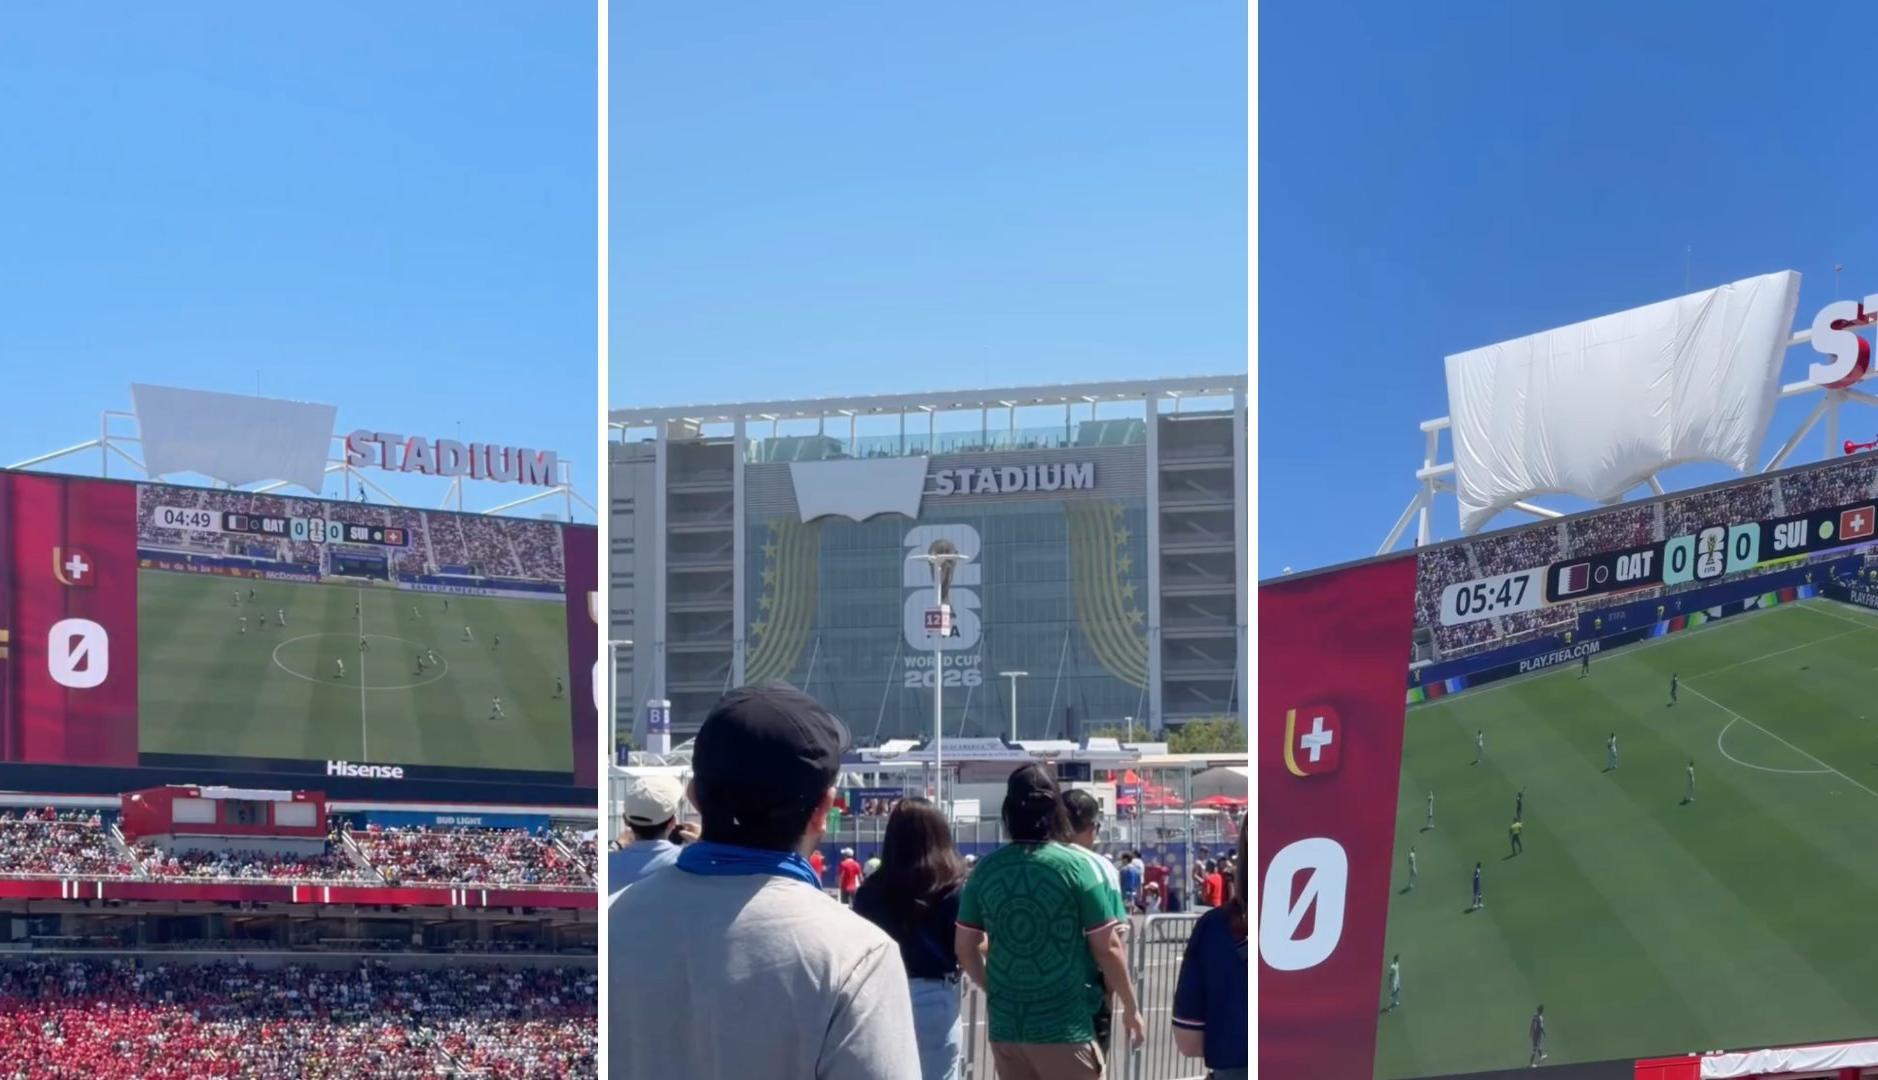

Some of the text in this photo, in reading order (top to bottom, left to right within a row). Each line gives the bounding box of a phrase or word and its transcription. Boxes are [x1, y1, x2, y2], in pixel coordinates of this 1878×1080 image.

[346, 429, 558, 487] STADIUM
[935, 462, 1094, 496] STADIUM
[164, 509, 211, 528] 04:49
[263, 518, 285, 533] QAT
[295, 522, 304, 536] 0
[330, 525, 339, 539] 0
[350, 527, 369, 541] SUI
[1774, 519, 1808, 551] SUI
[1736, 532, 1751, 561] 0
[1616, 550, 1654, 582] QAT
[1672, 545, 1687, 574] 0
[1455, 574, 1530, 616] 05:47
[48, 618, 109, 688] 0
[904, 655, 982, 667] WORD CUP
[1519, 640, 1600, 673] PLAY.FIFA.COM
[904, 669, 982, 688] 2026
[650, 709, 660, 723] B
[327, 760, 403, 778] Hisense
[436, 816, 482, 826] BUD LIGHT
[1258, 837, 1348, 971] 0
